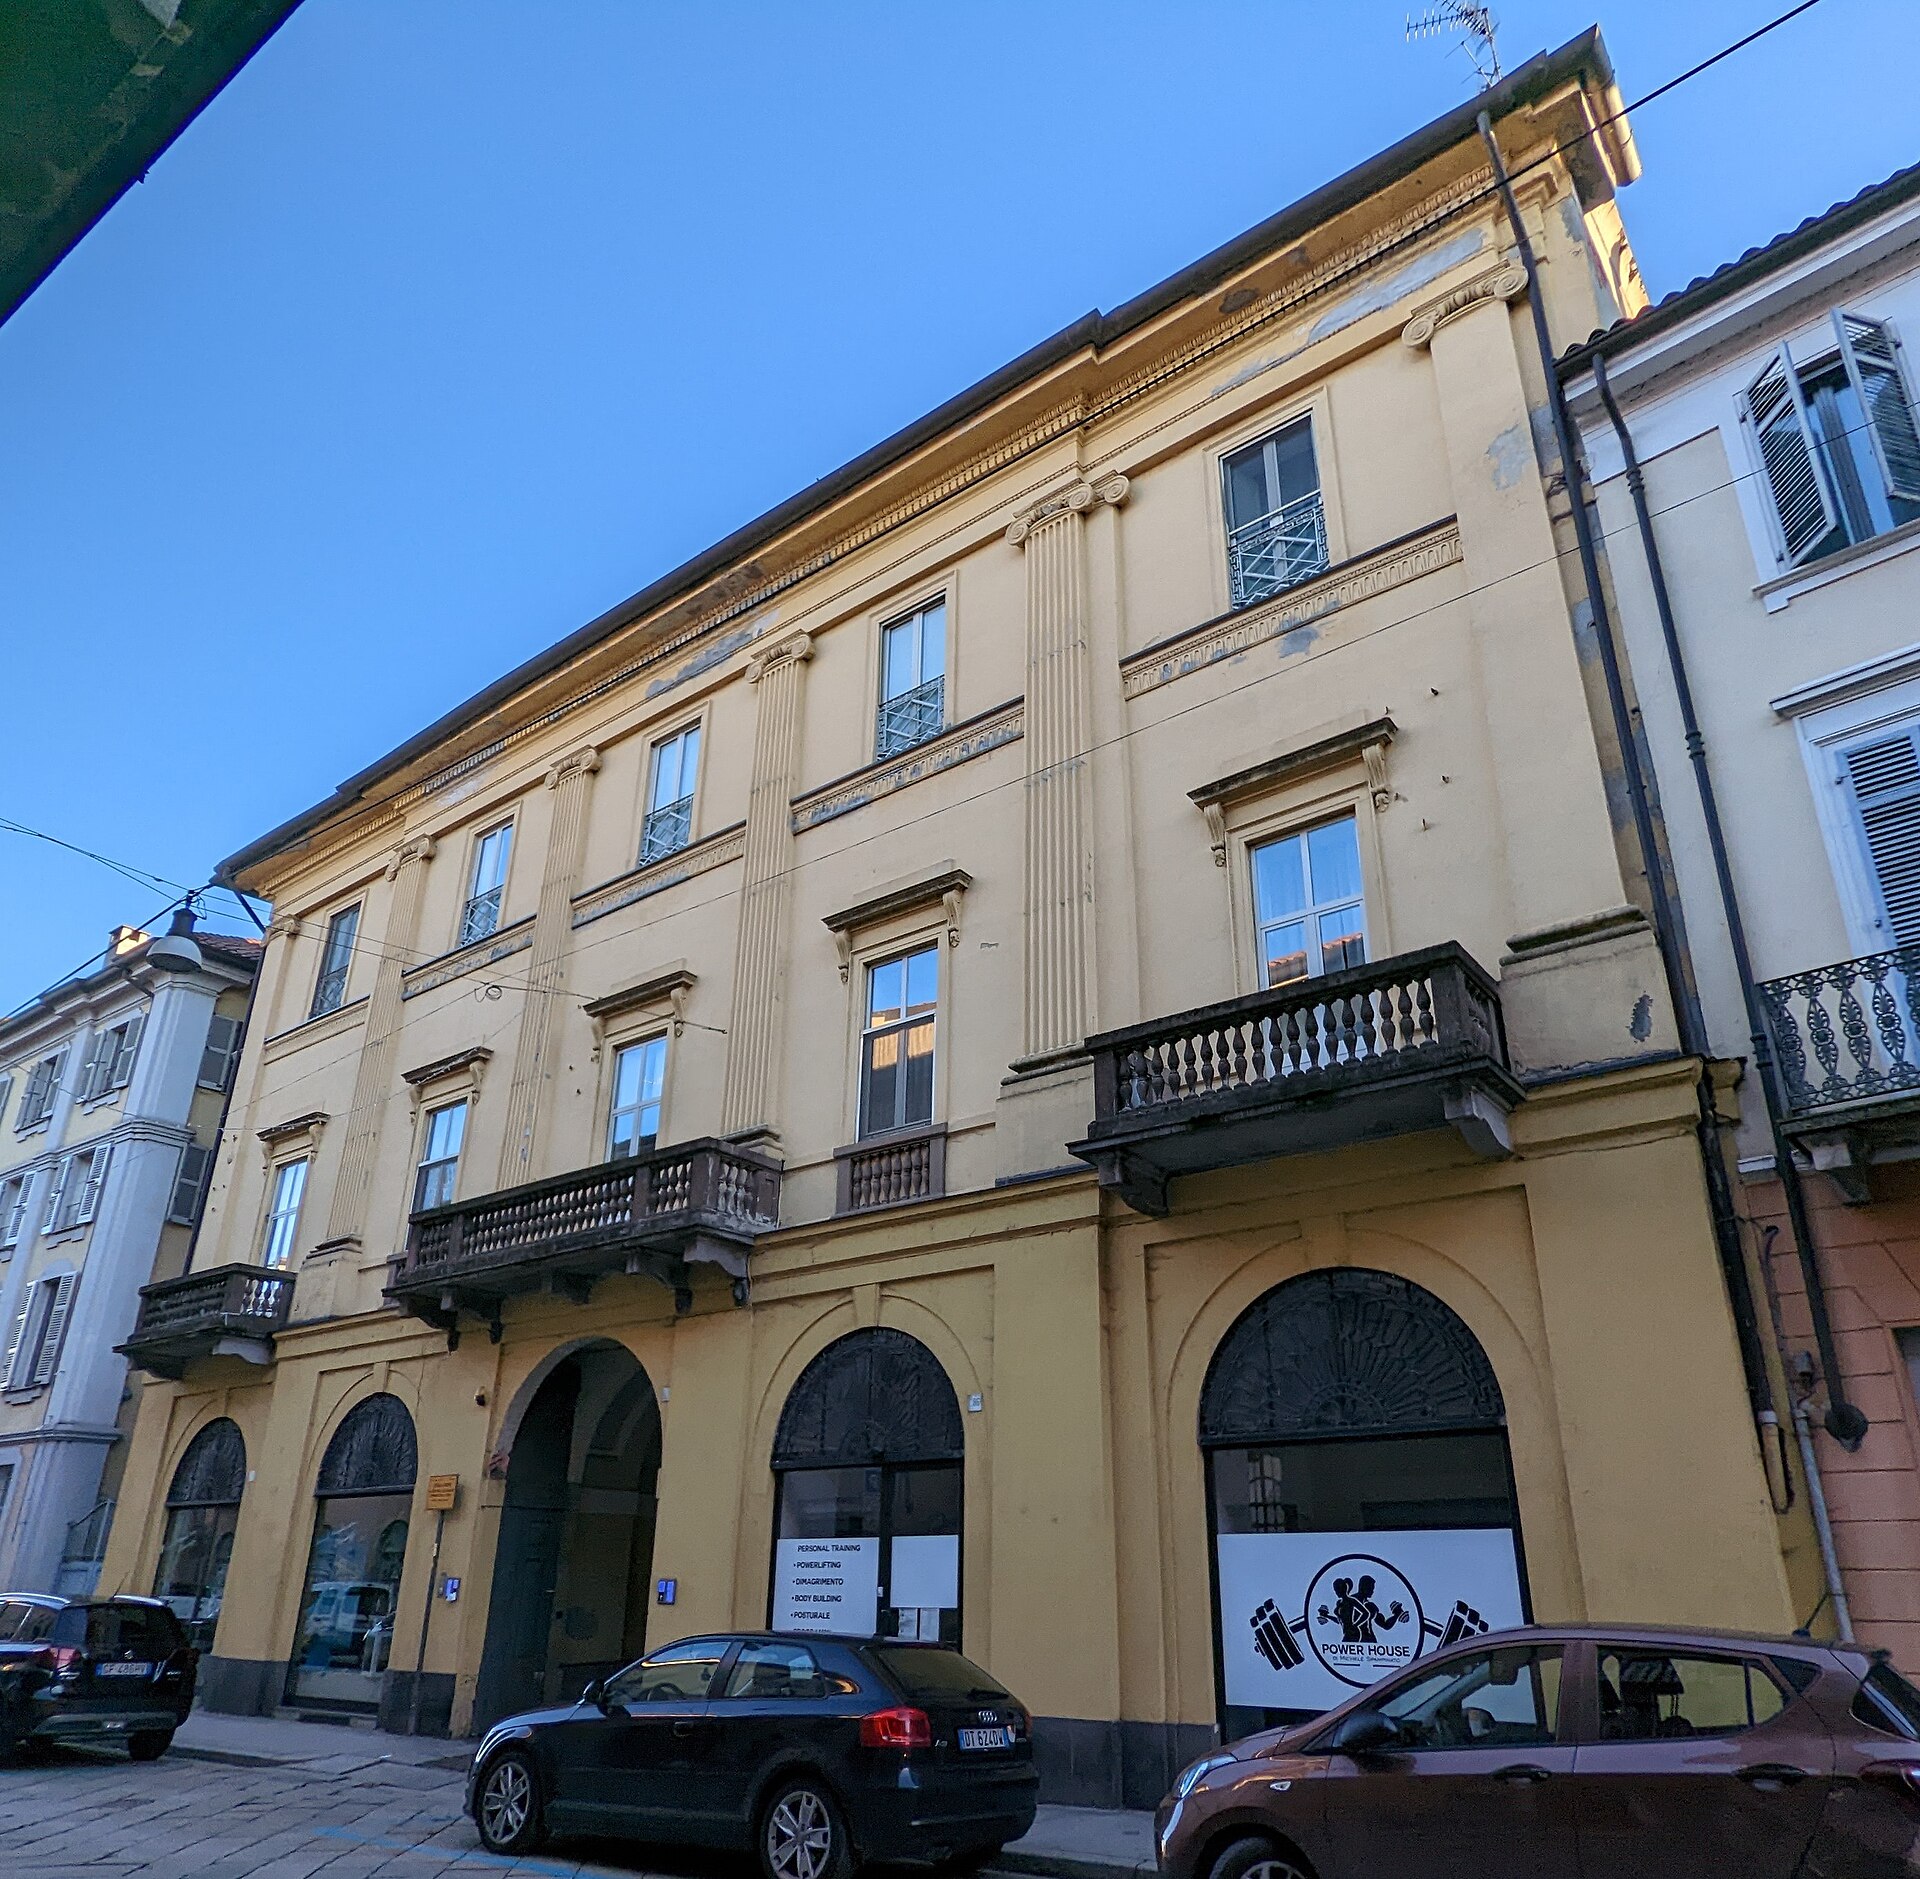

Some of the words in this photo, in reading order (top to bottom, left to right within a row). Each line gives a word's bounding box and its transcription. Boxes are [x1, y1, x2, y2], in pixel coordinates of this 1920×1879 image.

[797, 1544, 830, 1552] PERSONAL
[831, 1544, 861, 1552] TRAINING
[796, 1561, 842, 1569] POWERLIFTING
[795, 1578, 844, 1586] DIMAGRIMENTO
[794, 1594, 812, 1602] BODY
[793, 1611, 831, 1619] POSTURALE
[1321, 1643, 1364, 1656] POWER
[1367, 1645, 1411, 1657] HOUSE
[964, 1730, 975, 1747] DT
